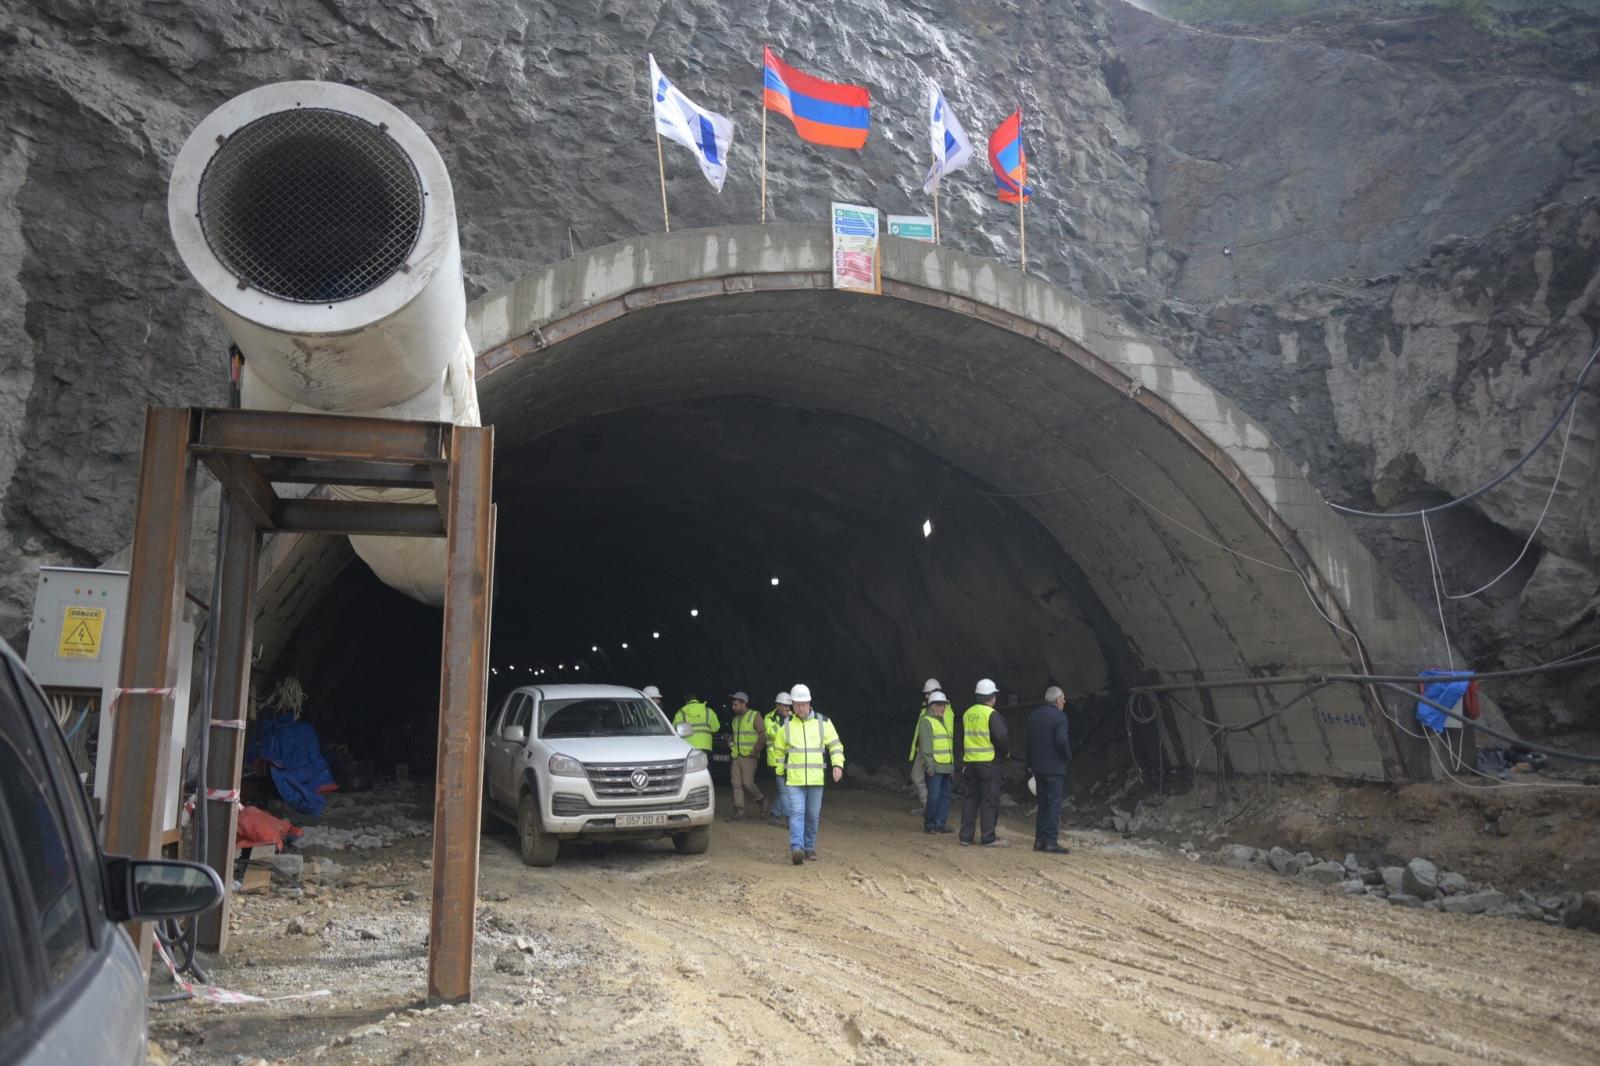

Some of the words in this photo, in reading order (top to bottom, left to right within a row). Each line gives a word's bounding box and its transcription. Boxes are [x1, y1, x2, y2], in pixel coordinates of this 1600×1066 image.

[71, 610, 99, 618] DANGER
[626, 815, 641, 825] 057
[642, 815, 654, 825] DD
